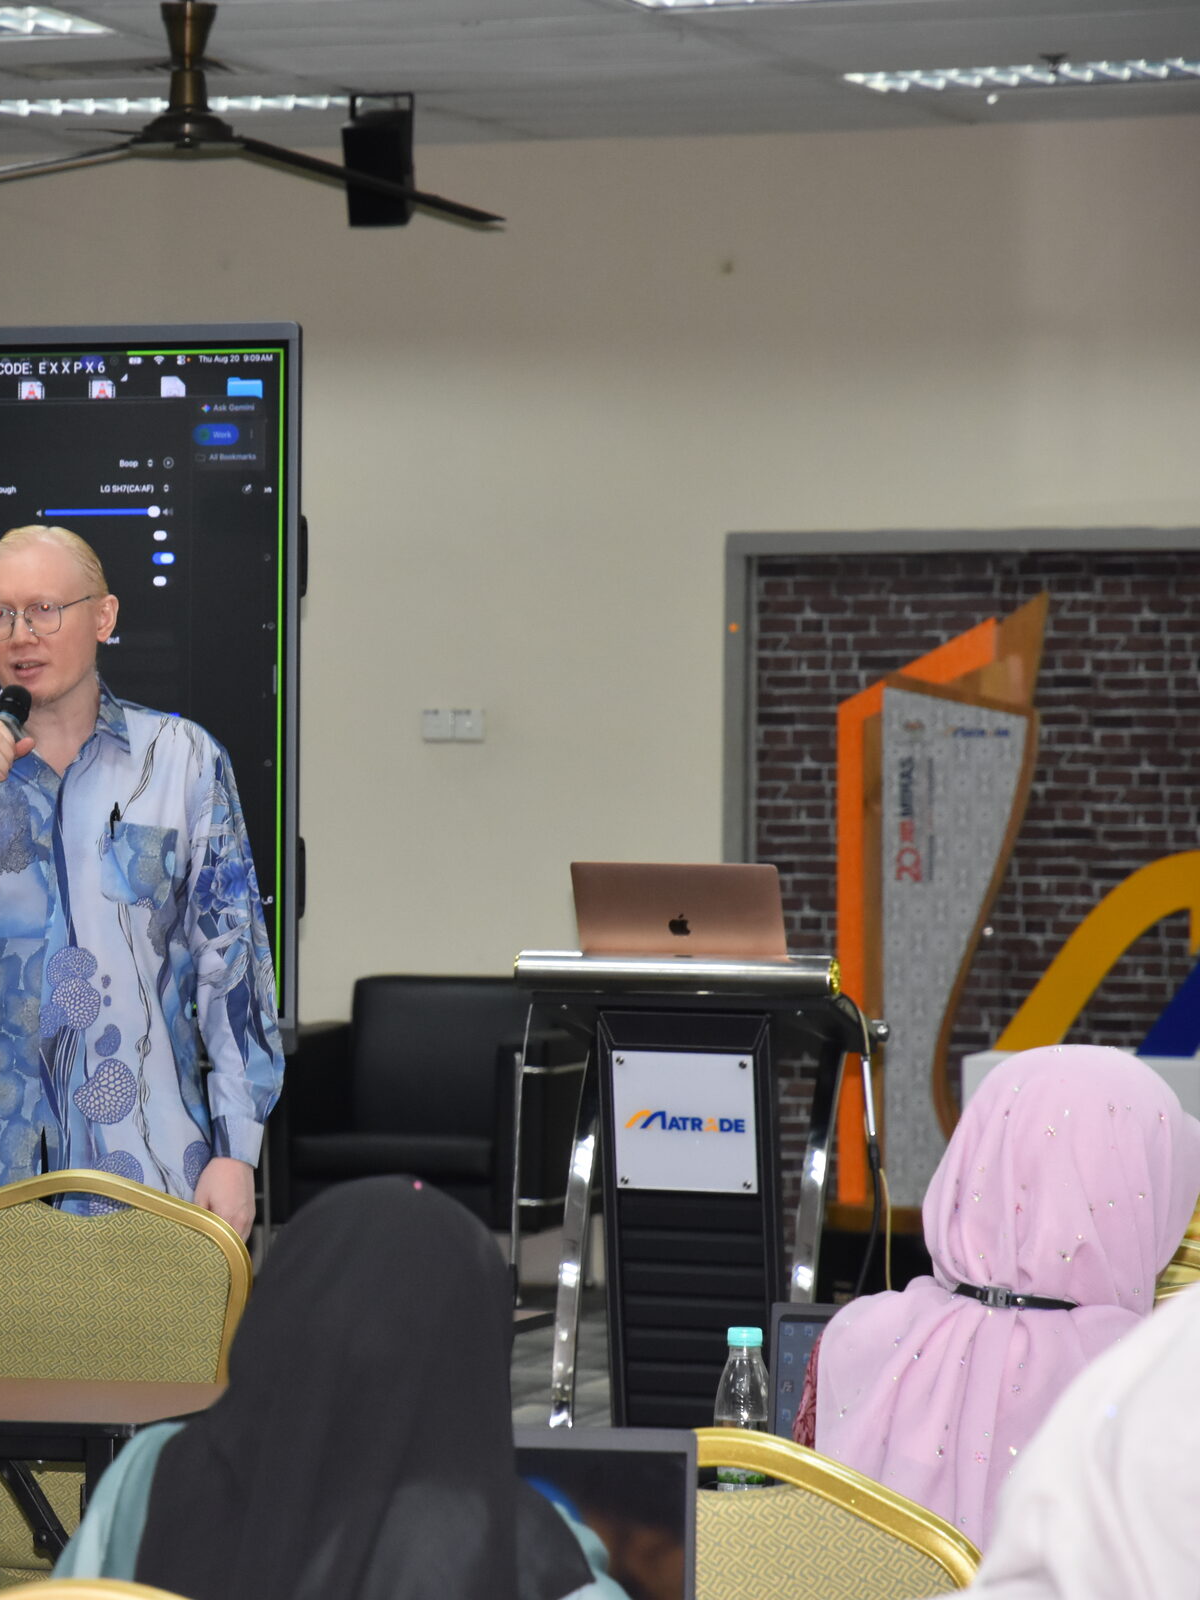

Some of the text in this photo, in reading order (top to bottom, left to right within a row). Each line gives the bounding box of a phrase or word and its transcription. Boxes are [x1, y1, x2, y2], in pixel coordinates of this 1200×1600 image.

[198, 355, 213, 363] Thu
[214, 355, 228, 364] Aug
[230, 355, 240, 363] 20
[213, 403, 255, 412] Ask Gemini
[212, 431, 232, 439] Work
[219, 453, 256, 461] Bookmarks
[119, 459, 139, 468] Boop
[100, 485, 111, 493] LG
[106, 636, 120, 645] put
[624, 1109, 746, 1133] MATRADE
